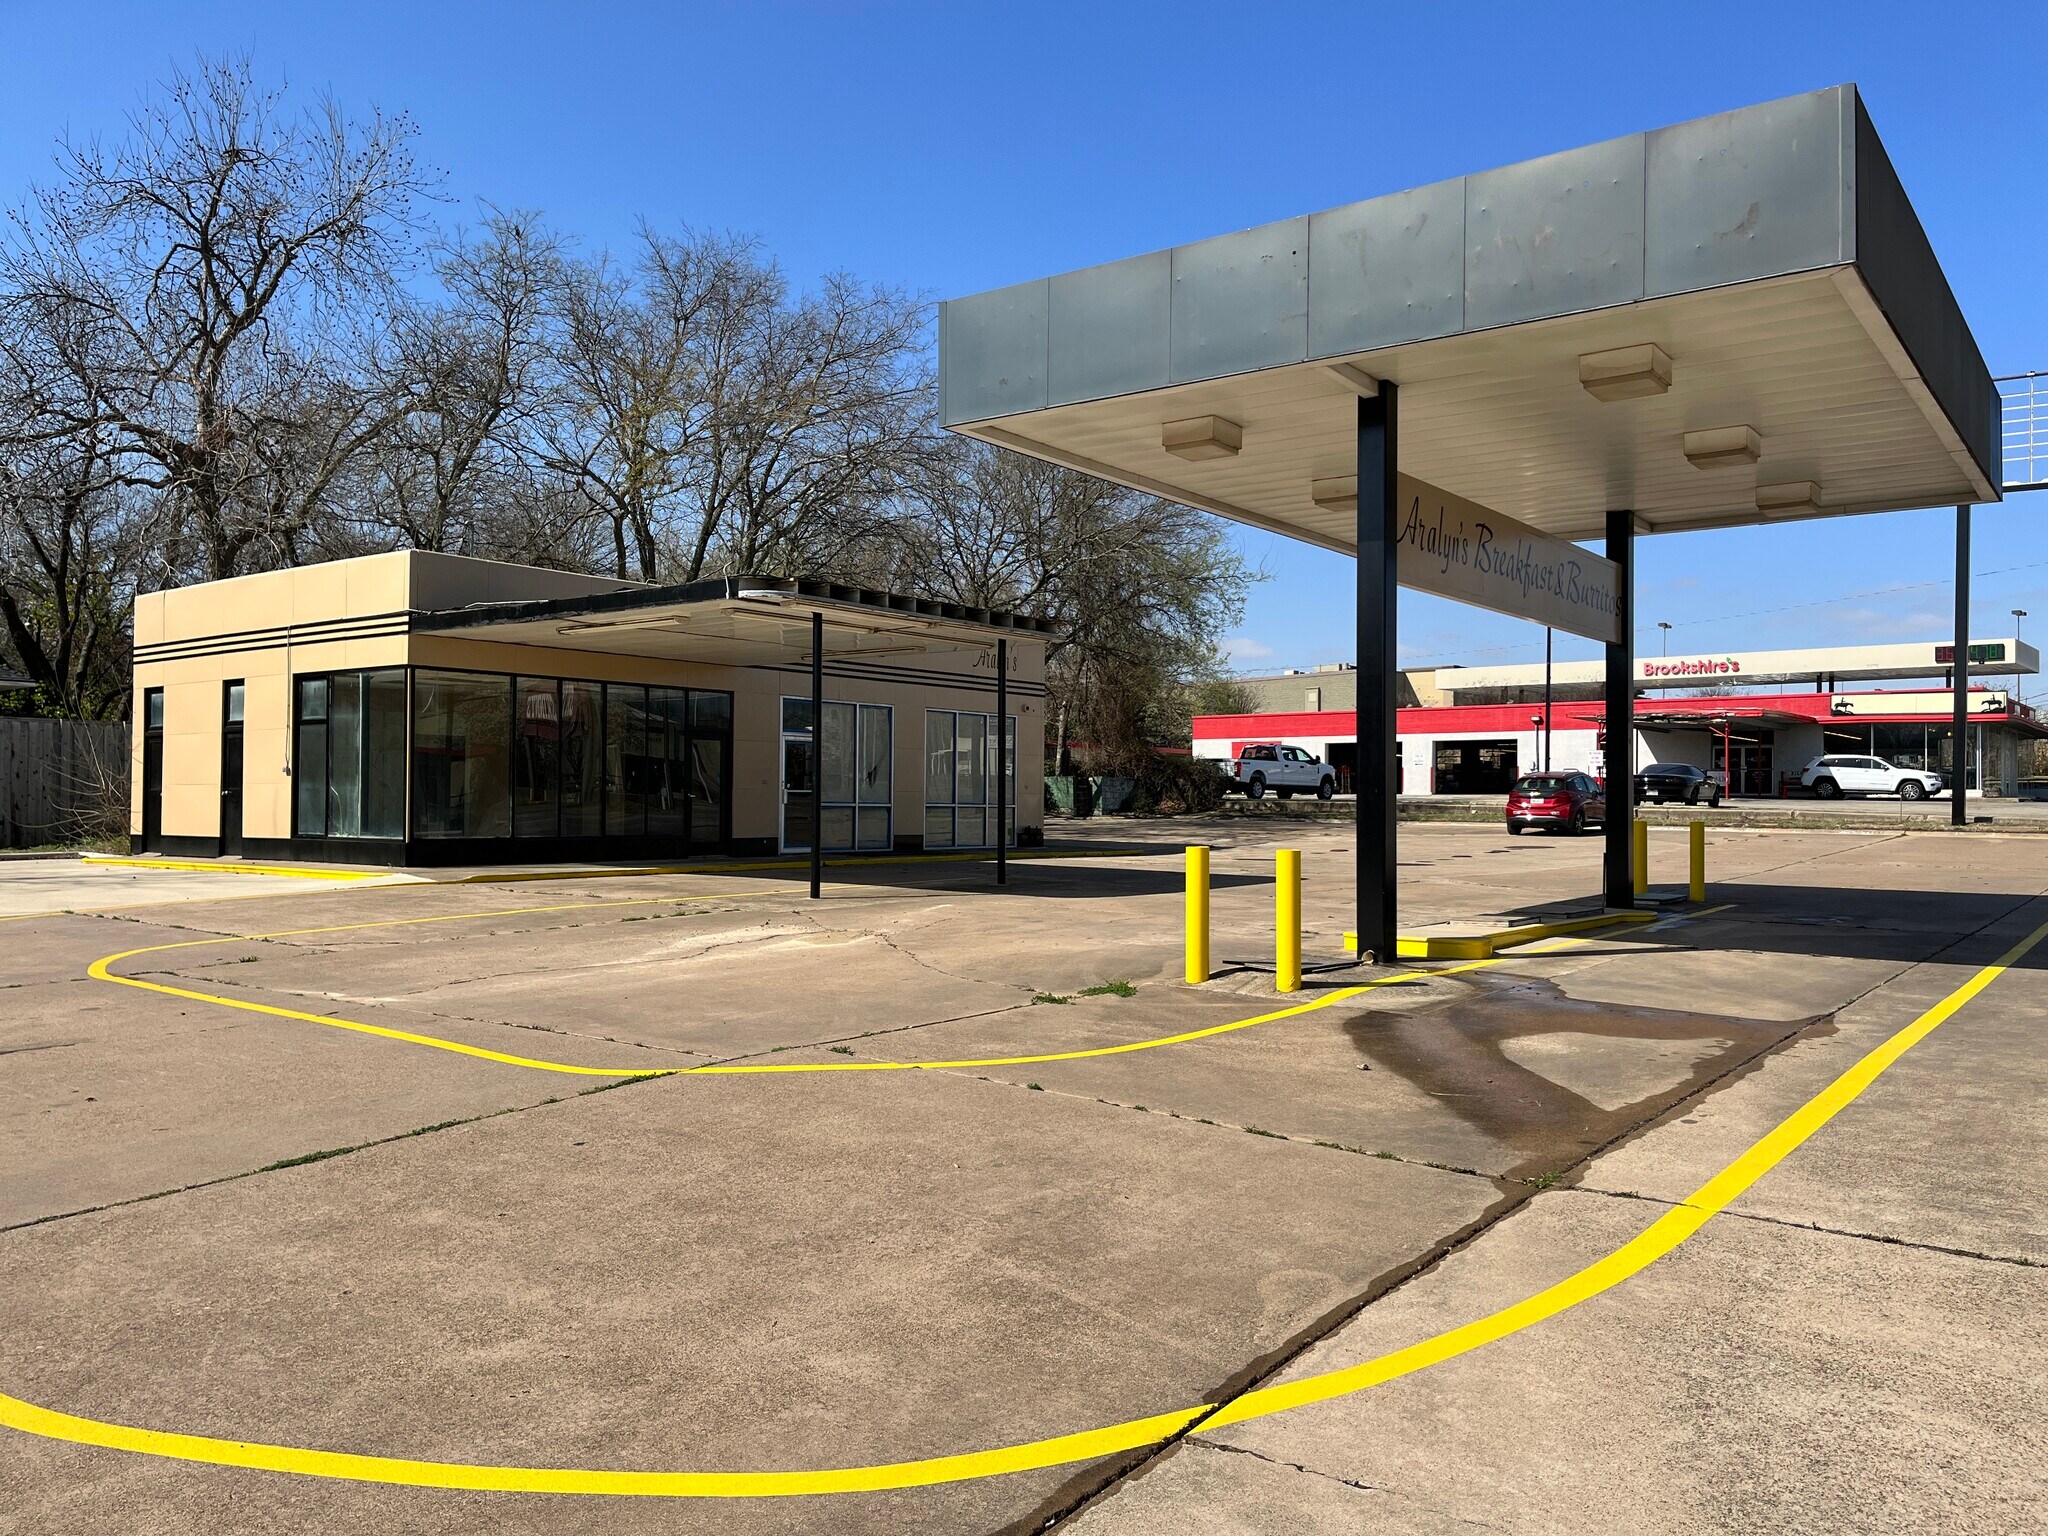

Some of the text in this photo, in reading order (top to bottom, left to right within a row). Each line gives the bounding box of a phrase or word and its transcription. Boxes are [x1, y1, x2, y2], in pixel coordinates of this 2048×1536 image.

[1397, 496, 1469, 574] Aralyn's
[1474, 523, 1553, 599] Breakfast
[1566, 560, 1622, 617] Burritos
[1643, 659, 1740, 676] Brookshire's
